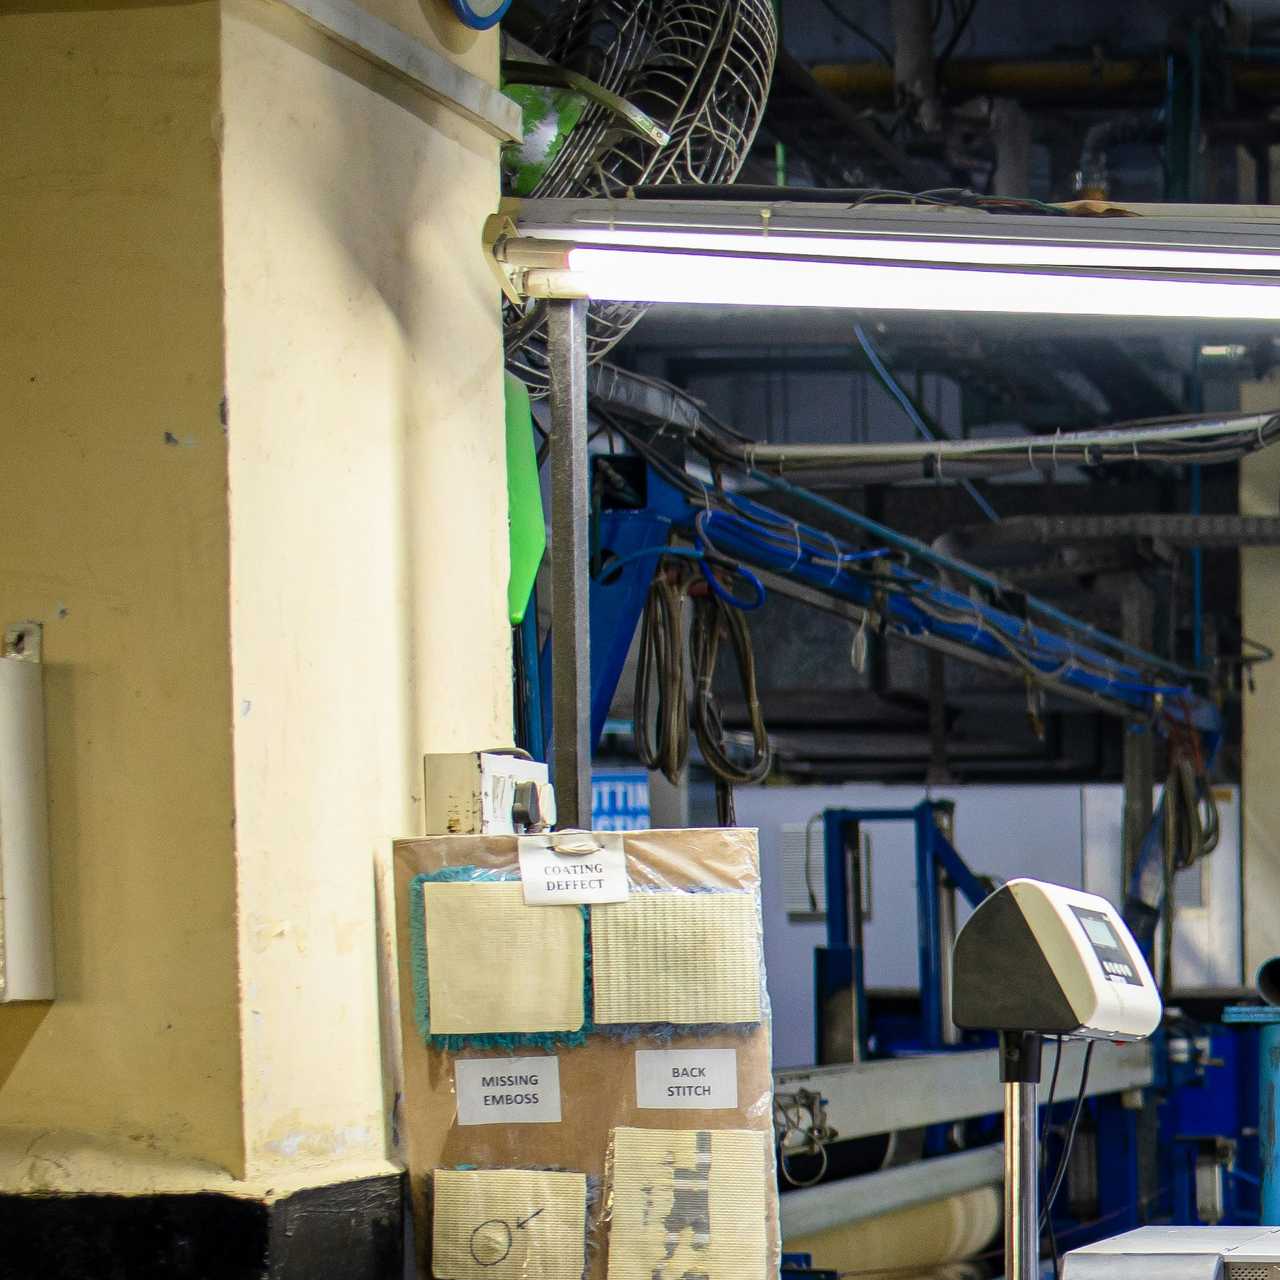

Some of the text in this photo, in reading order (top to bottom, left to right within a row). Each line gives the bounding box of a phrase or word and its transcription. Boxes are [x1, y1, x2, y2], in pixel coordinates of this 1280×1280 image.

[544, 863, 604, 876] COATING
[545, 879, 605, 892] DEFFECT
[672, 1066, 706, 1078] BACK
[481, 1074, 539, 1088] MISSING
[667, 1085, 712, 1097] STITCH
[483, 1093, 540, 1106] EMBOSS
